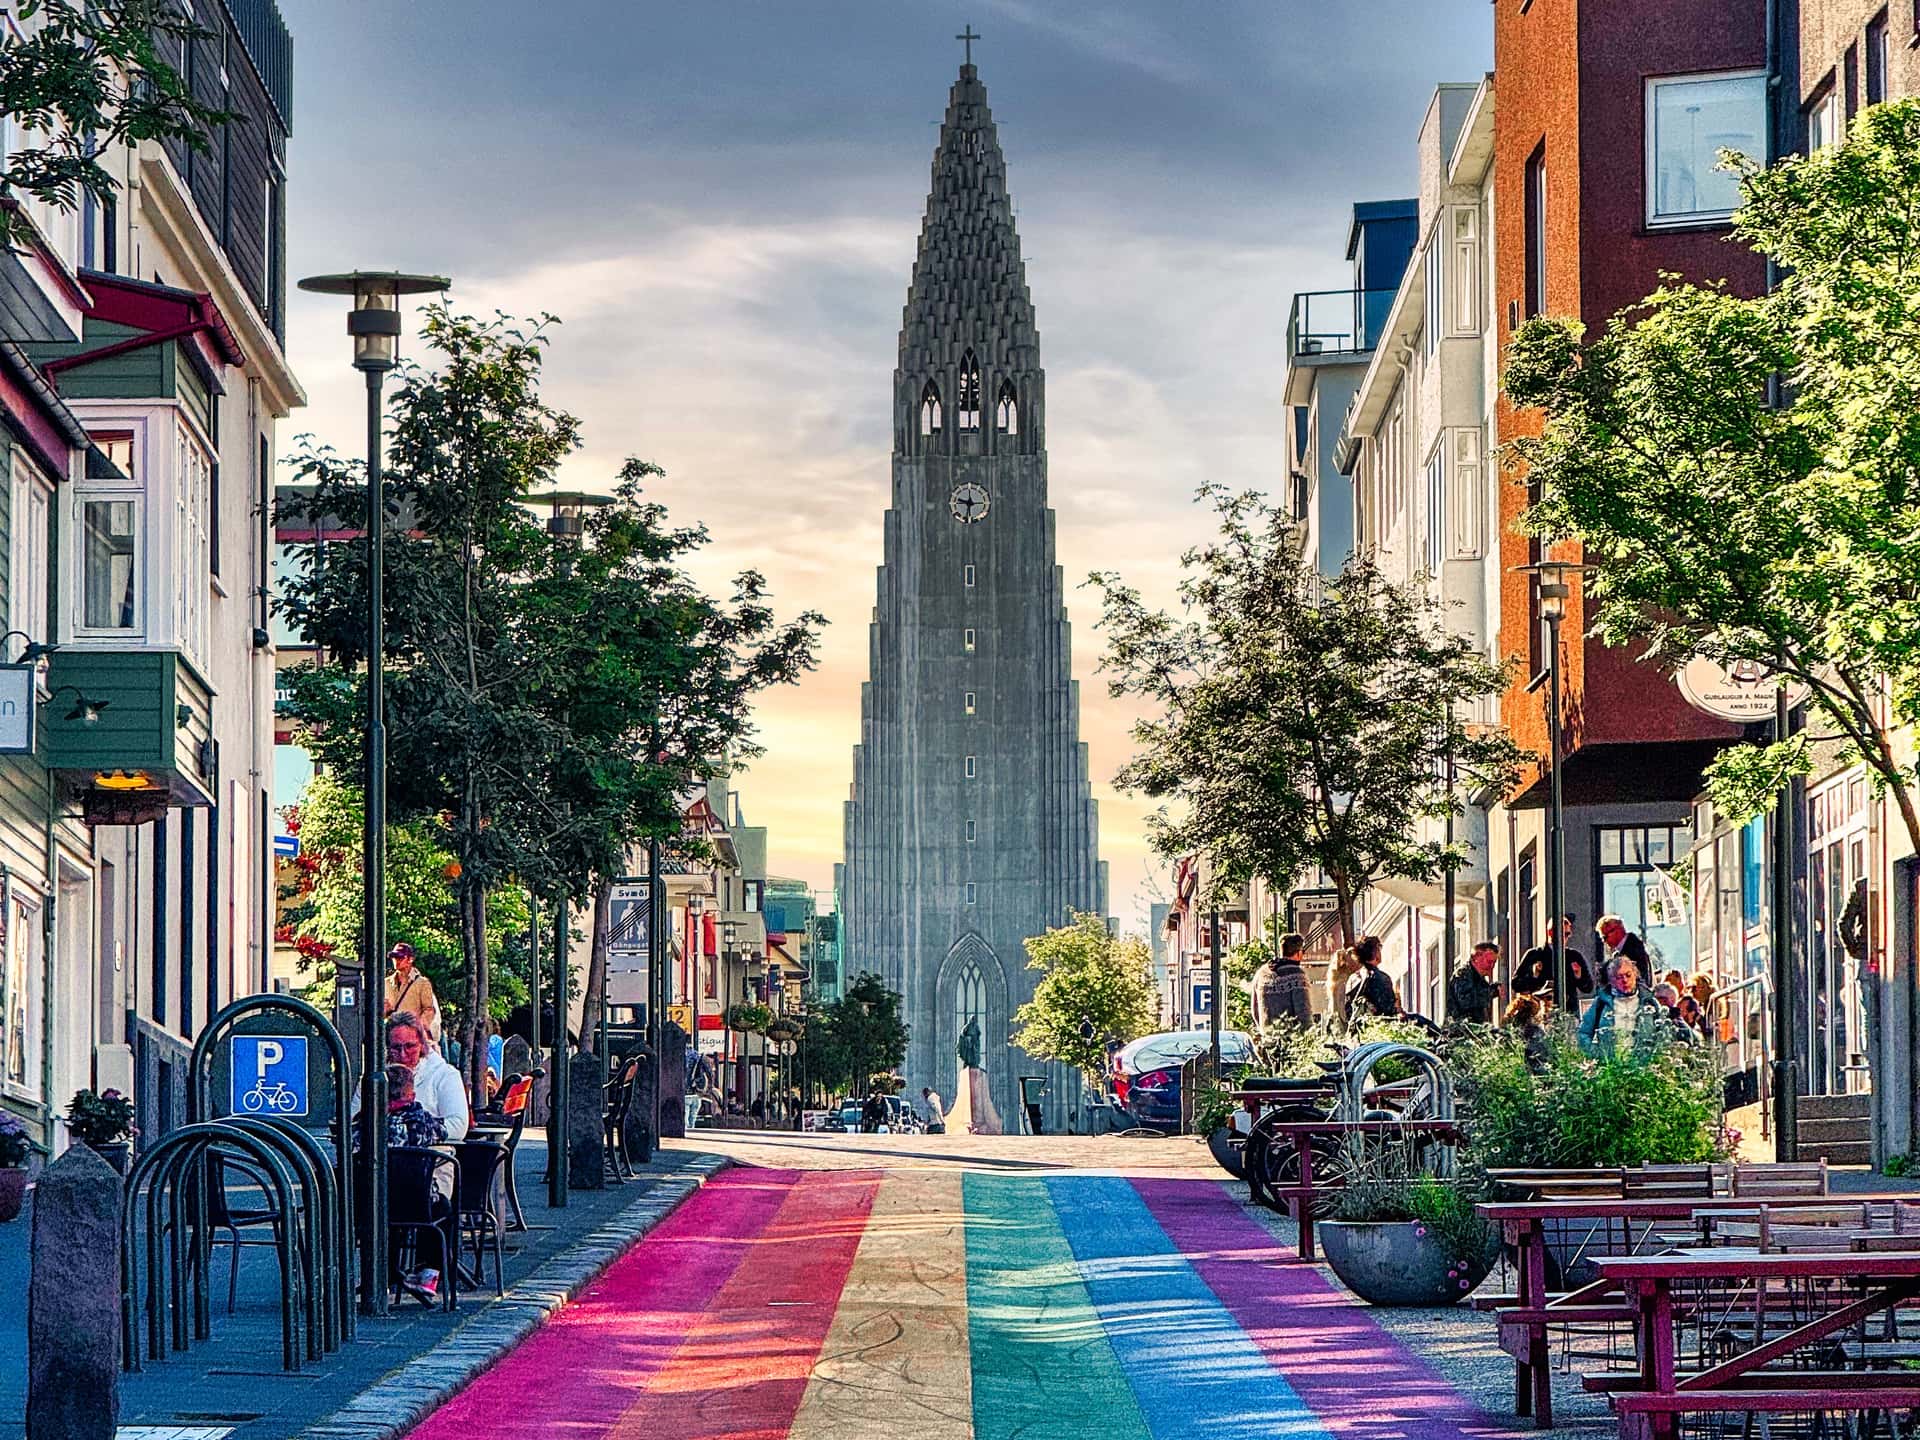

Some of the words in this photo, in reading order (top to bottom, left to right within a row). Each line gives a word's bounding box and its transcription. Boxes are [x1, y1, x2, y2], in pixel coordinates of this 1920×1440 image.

[618, 889, 648, 897] Svæði
[1305, 901, 1336, 909] Svæði
[341, 988, 353, 1003] P
[257, 1041, 284, 1077] P
